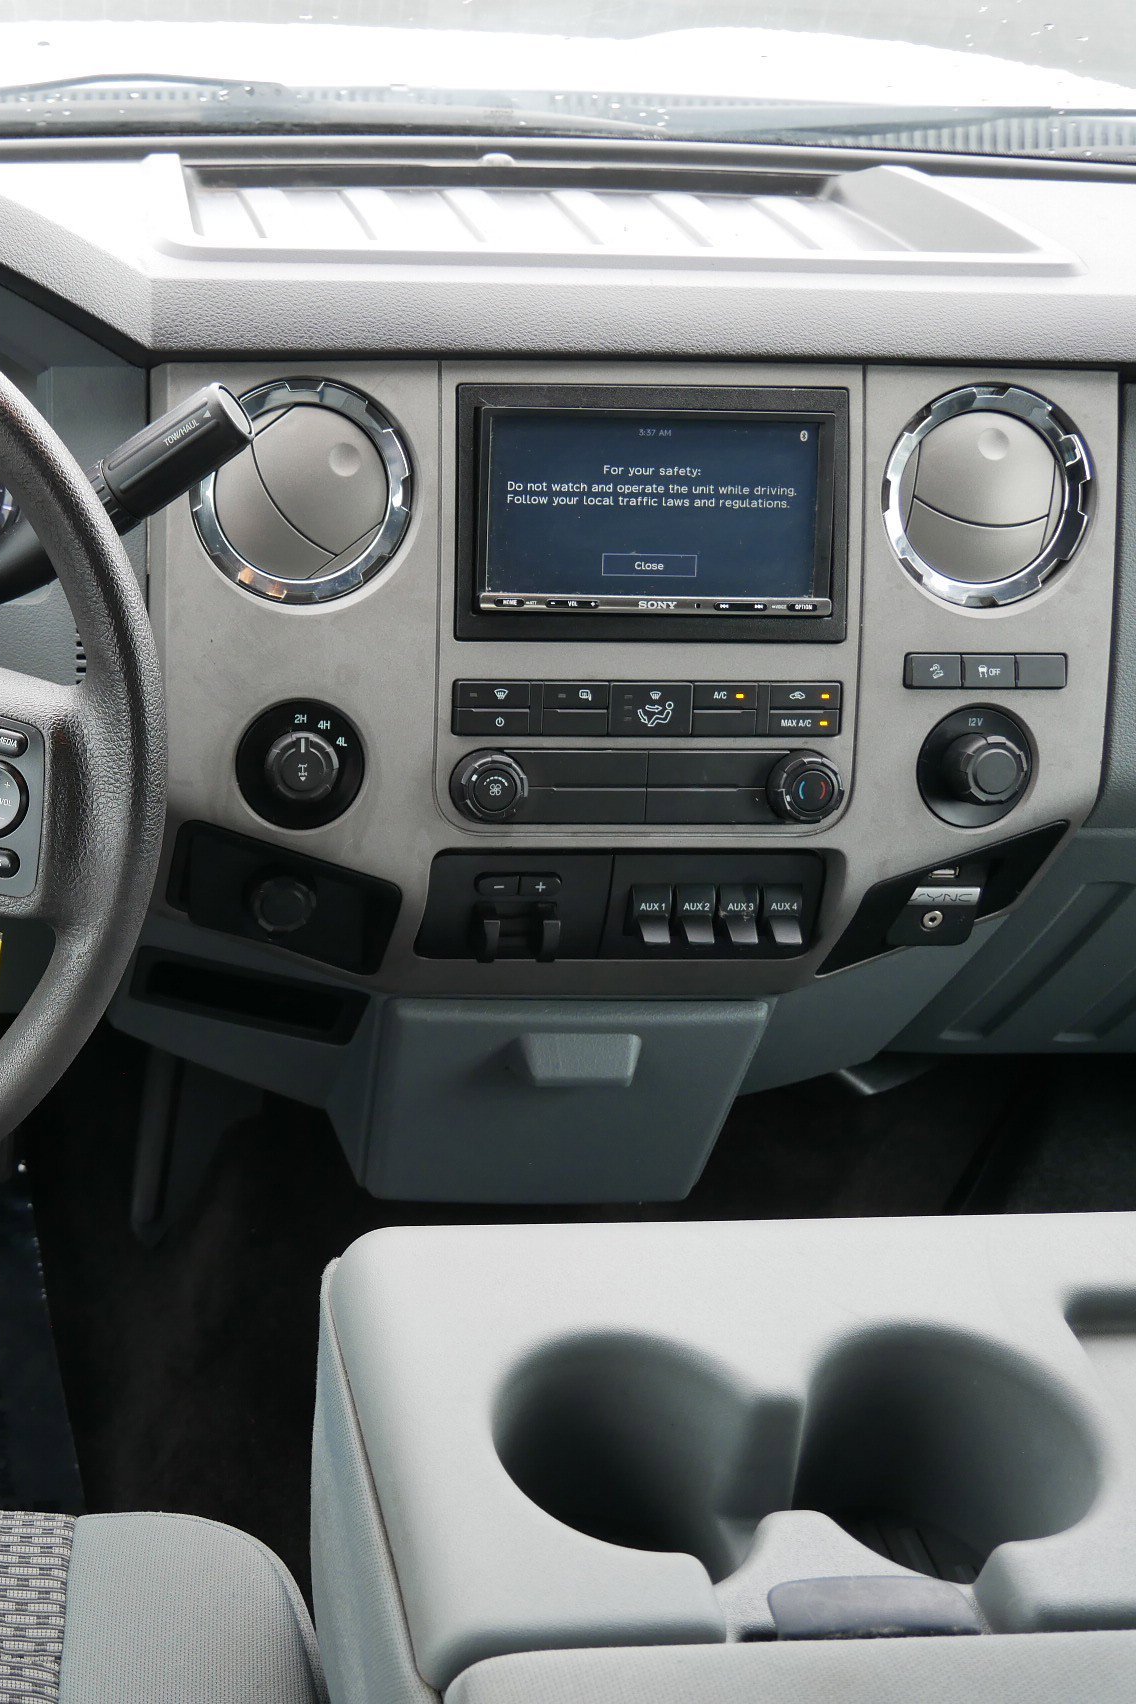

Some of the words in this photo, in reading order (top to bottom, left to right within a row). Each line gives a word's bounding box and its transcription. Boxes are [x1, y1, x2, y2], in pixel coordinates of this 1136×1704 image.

[163, 419, 200, 446] TOW/HAUL
[659, 429, 672, 437] AM
[603, 465, 624, 475] For
[628, 467, 654, 477] your
[659, 466, 701, 478] safety:
[507, 481, 524, 491] Do
[527, 482, 547, 491] not
[551, 482, 588, 492] watch
[592, 483, 613, 493] and
[617, 484, 665, 495] operate
[669, 484, 688, 494] the
[692, 484, 714, 494] unit
[718, 485, 749, 495] while
[754, 485, 797, 498] driving.
[507, 495, 548, 505] Follow
[552, 497, 578, 507] your
[583, 496, 614, 506] local
[618, 496, 658, 507] traffic
[662, 497, 690, 507] laws
[694, 497, 715, 507] and
[719, 498, 790, 510] regulations.
[634, 560, 664, 570] Close
[638, 601, 677, 609] SONY
[988, 668, 1001, 676] OFF
[713, 691, 727, 699] A/C
[294, 714, 307, 724] 2H
[781, 719, 796, 727] MAX
[968, 717, 983, 727] 12V
[317, 720, 331, 730] 4H
[336, 737, 347, 747] 4L
[0, 798, 12, 807] VOL
[909, 893, 973, 902] SYNC
[640, 902, 660, 911] AUX
[661, 902, 665, 911] 1
[683, 902, 704, 911] AUX
[705, 902, 710, 911] 2
[727, 902, 747, 911] AUX
[748, 902, 754, 911] 3
[771, 902, 791, 911] AUX
[792, 902, 798, 911] 4
